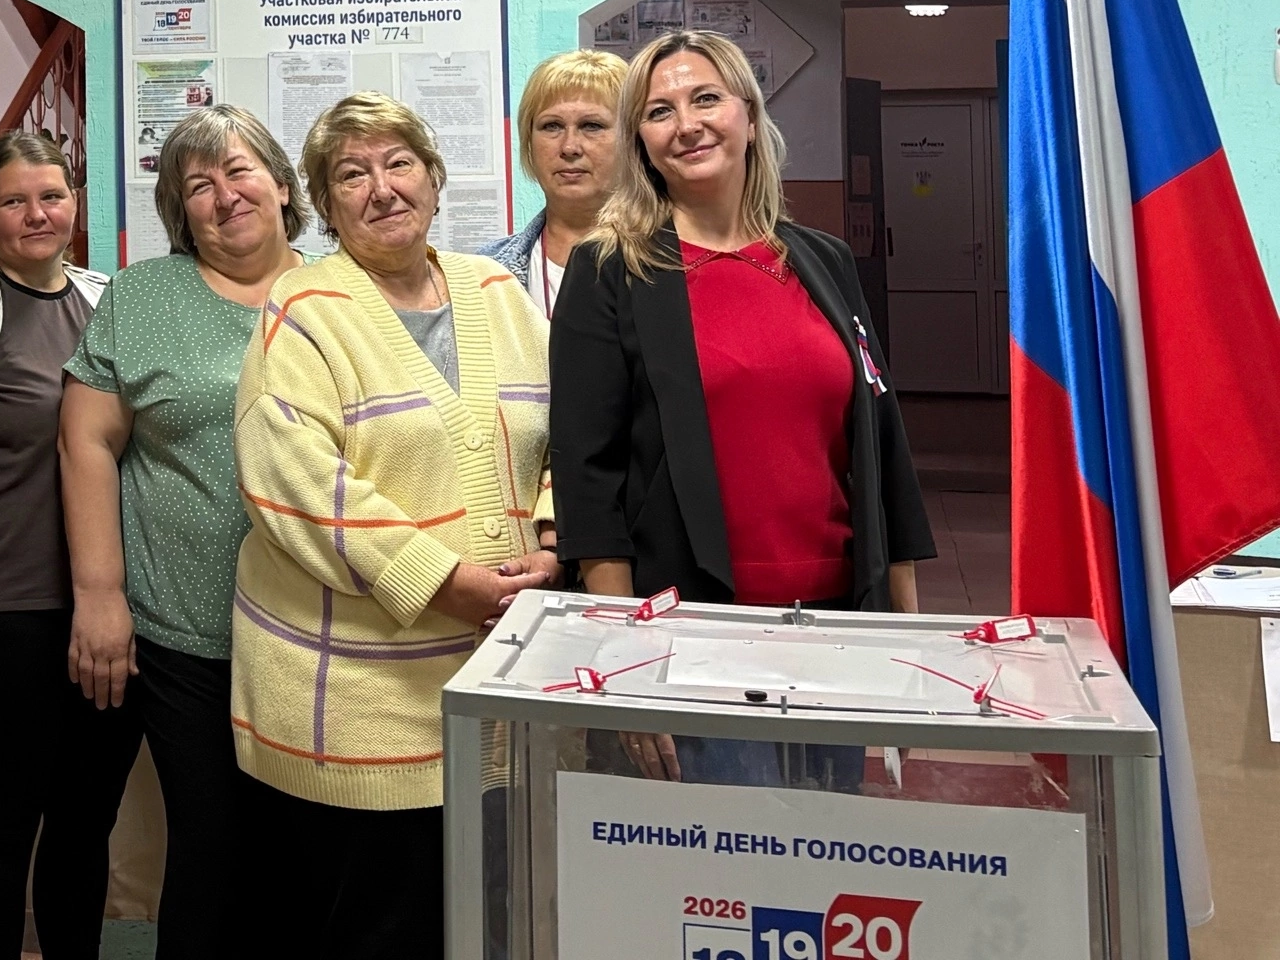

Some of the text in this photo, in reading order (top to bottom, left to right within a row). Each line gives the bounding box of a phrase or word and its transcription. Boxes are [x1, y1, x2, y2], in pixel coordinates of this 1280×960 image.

[157, 20, 166, 28] 18
[167, 15, 177, 24] 19
[178, 11, 190, 19] 20
[264, 9, 462, 26] комиссия избирательного
[288, 27, 410, 49] участка № 774
[592, 822, 1007, 876] ЕДИНЫЙ ДЕНЬ ГОЛОСОВАНИЯ
[683, 896, 746, 919] 2026
[831, 913, 902, 960] 20
